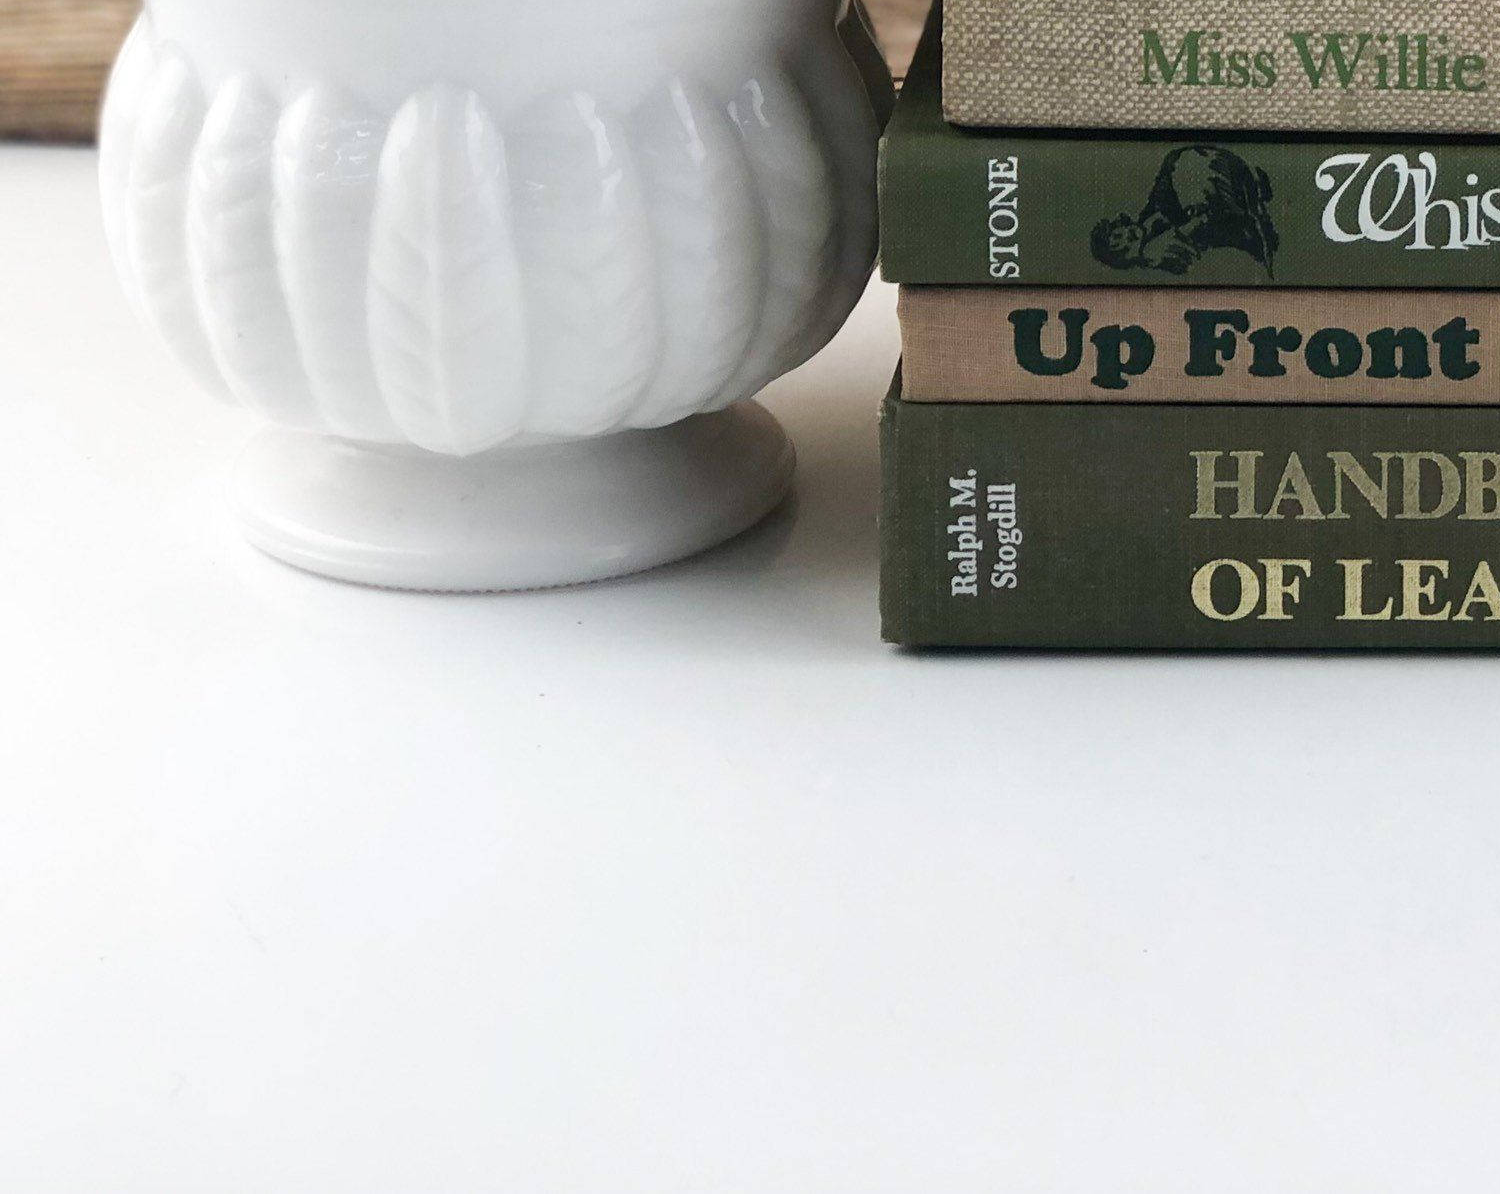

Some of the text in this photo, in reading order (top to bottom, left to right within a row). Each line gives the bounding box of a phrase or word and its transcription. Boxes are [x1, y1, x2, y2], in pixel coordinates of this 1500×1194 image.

[1137, 29, 1487, 93] Miss Willie
[988, 156, 1020, 279] STONE
[1008, 307, 1154, 390] Up
[1184, 308, 1481, 381] Front
[947, 468, 983, 597] Ralph M.
[986, 483, 1022, 589] Stogdill
[1190, 557, 1312, 621] OF
